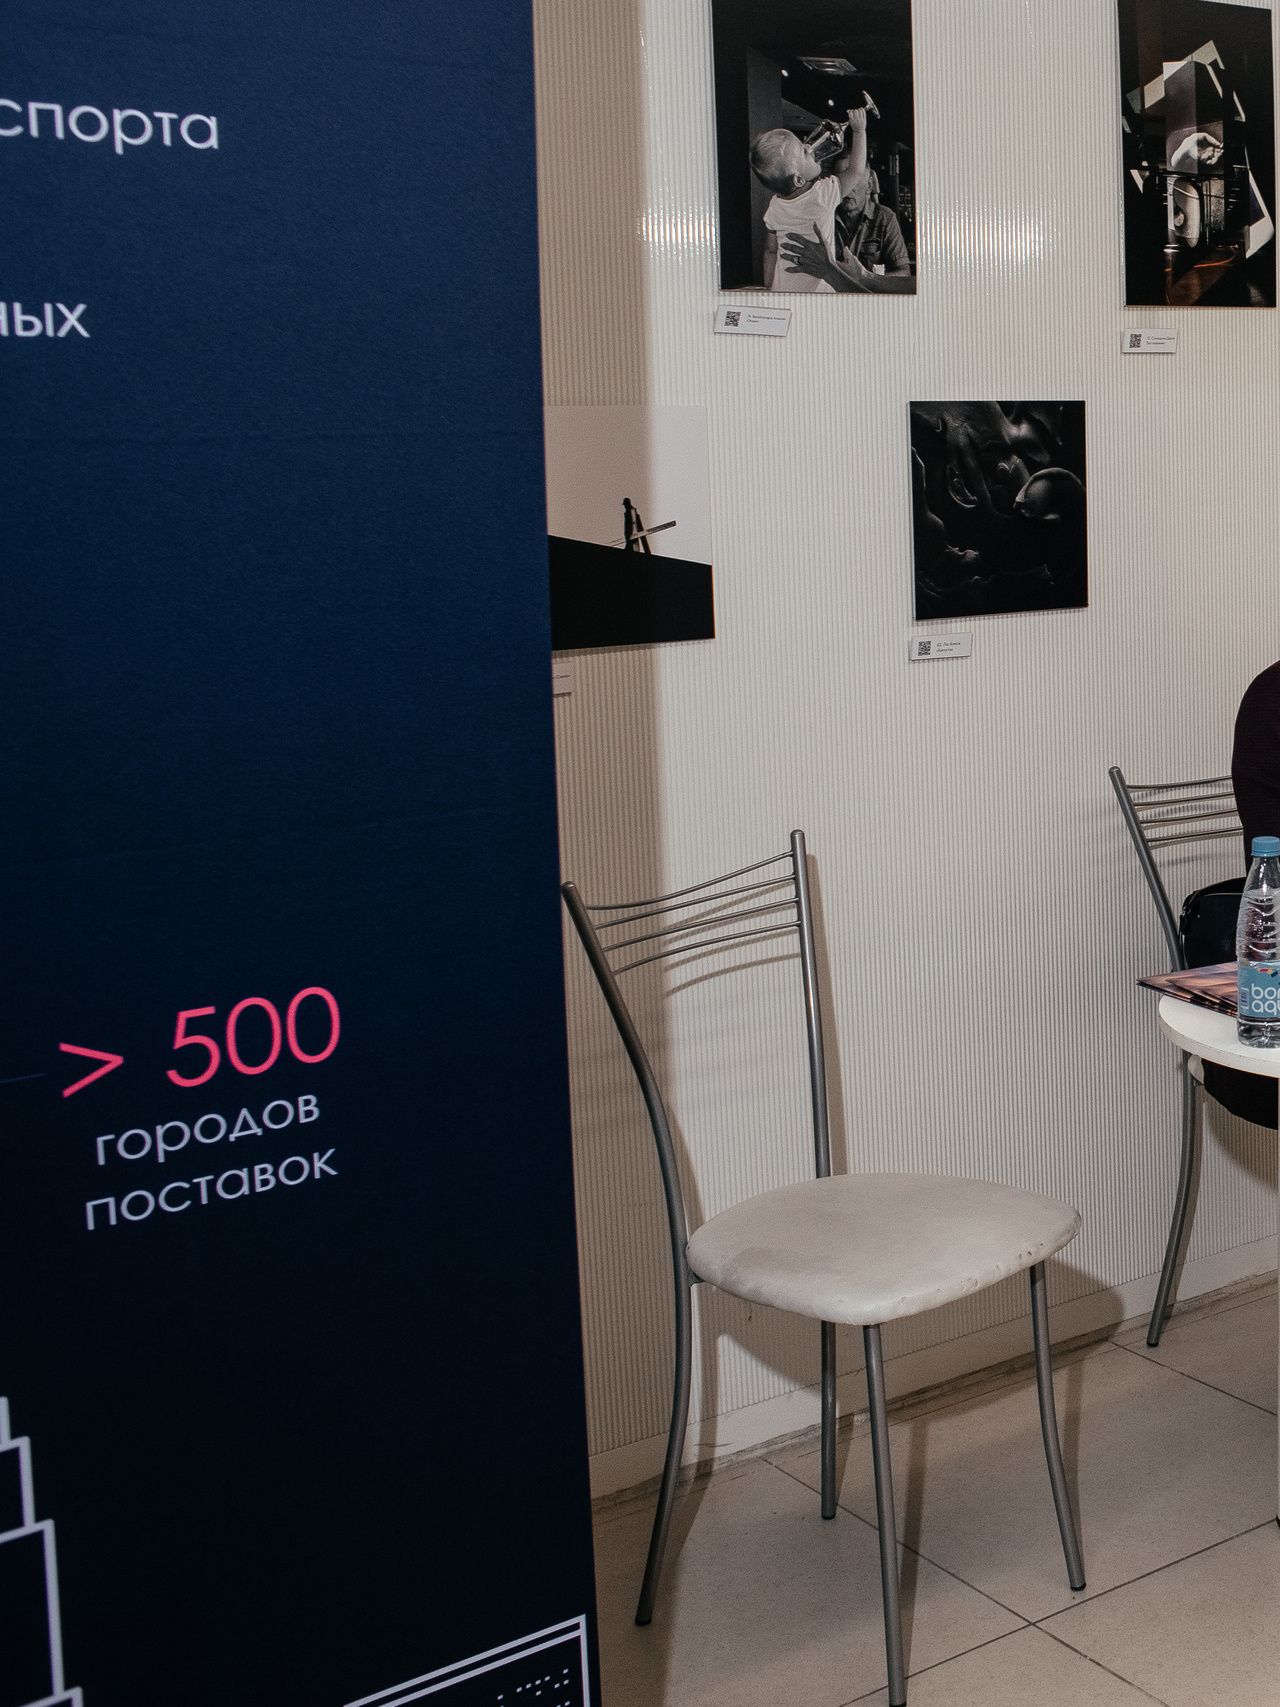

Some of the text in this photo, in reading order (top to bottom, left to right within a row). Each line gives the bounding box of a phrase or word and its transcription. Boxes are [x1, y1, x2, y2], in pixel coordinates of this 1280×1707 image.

[0, 302, 90, 338] ых
[166, 986, 341, 1088] 500
[96, 1093, 319, 1165] городов
[85, 1148, 338, 1230] поставок
